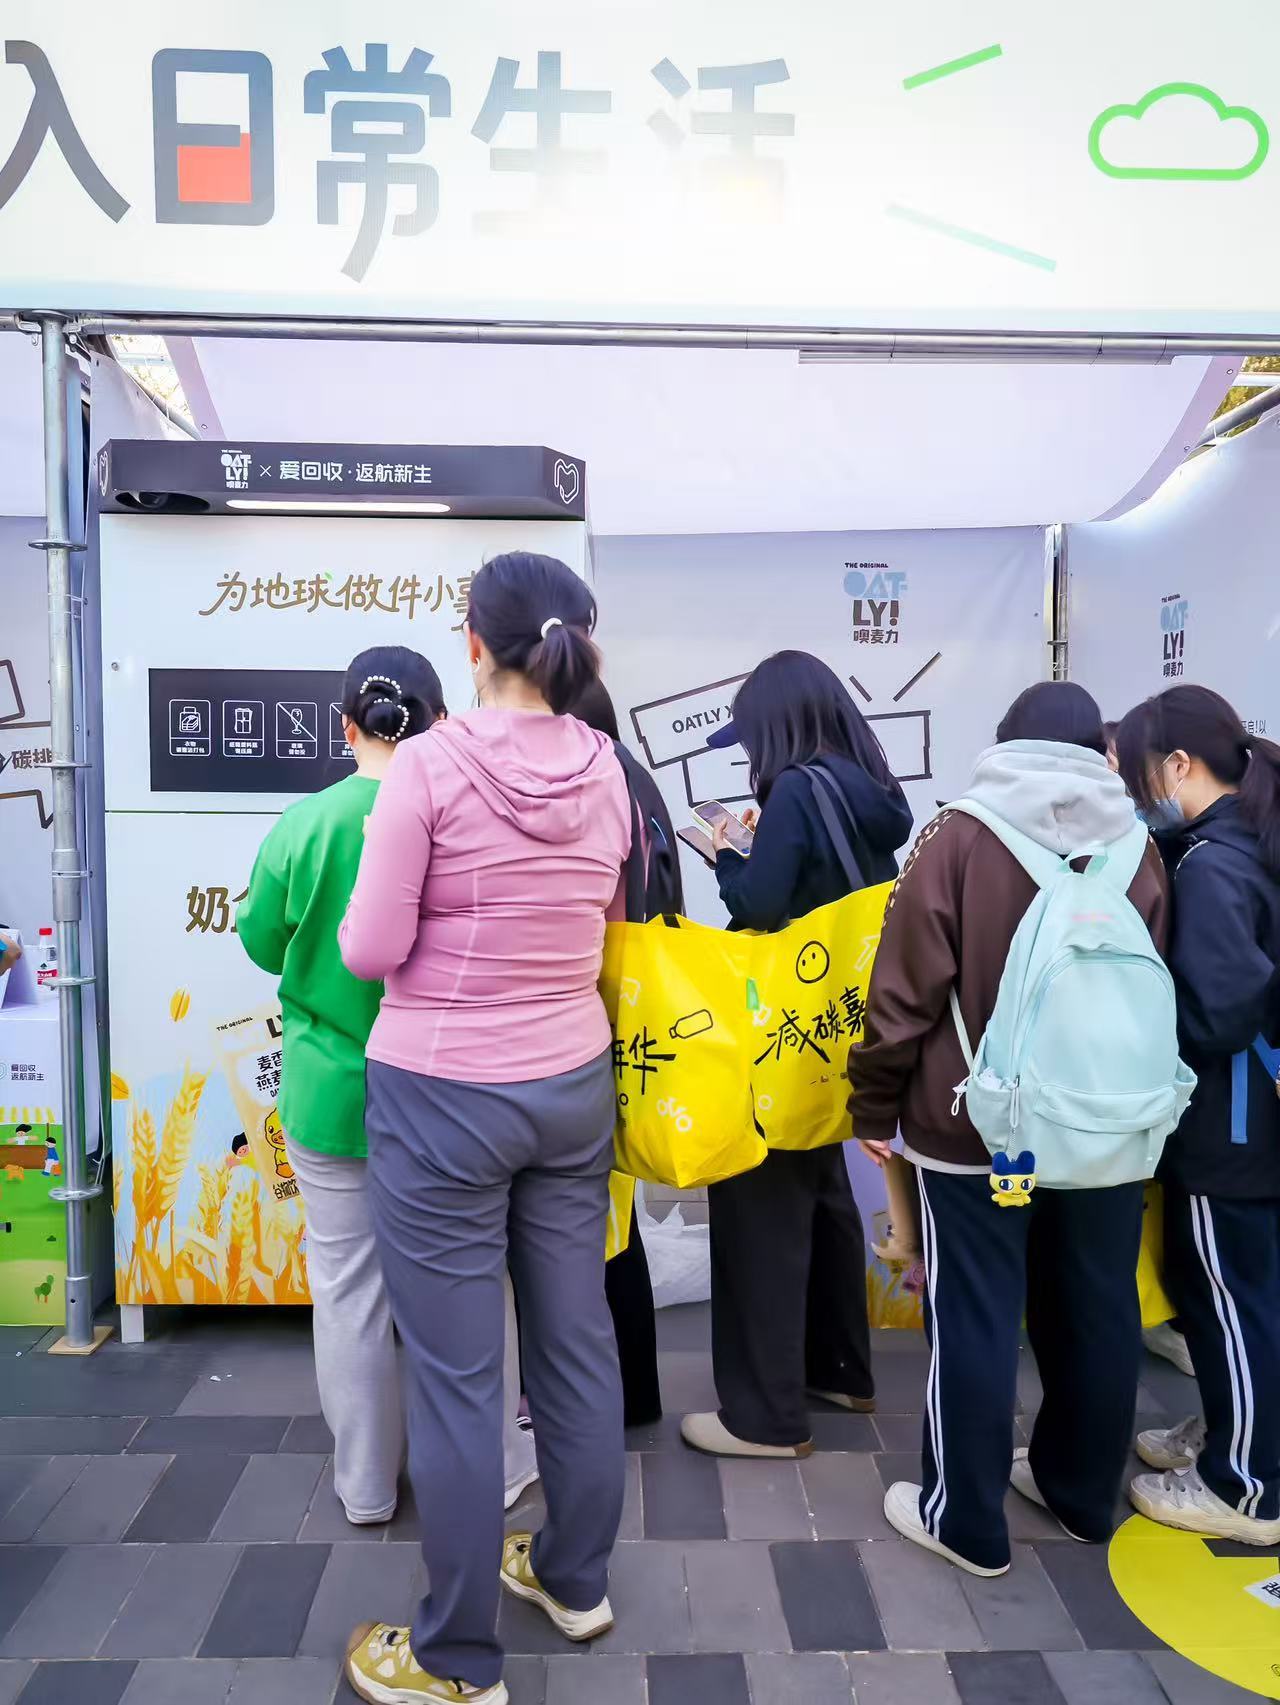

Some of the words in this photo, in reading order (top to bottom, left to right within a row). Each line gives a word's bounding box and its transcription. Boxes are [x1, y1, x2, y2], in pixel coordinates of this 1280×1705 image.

[0, 41, 797, 282] 入日常生活
[225, 467, 248, 481] LY!
[853, 599, 899, 627] LY!
[853, 628, 899, 644] 噢麦力
[1163, 630, 1184, 660] LY!
[671, 707, 721, 734] OATLY
[216, 1023, 229, 1032] THE
